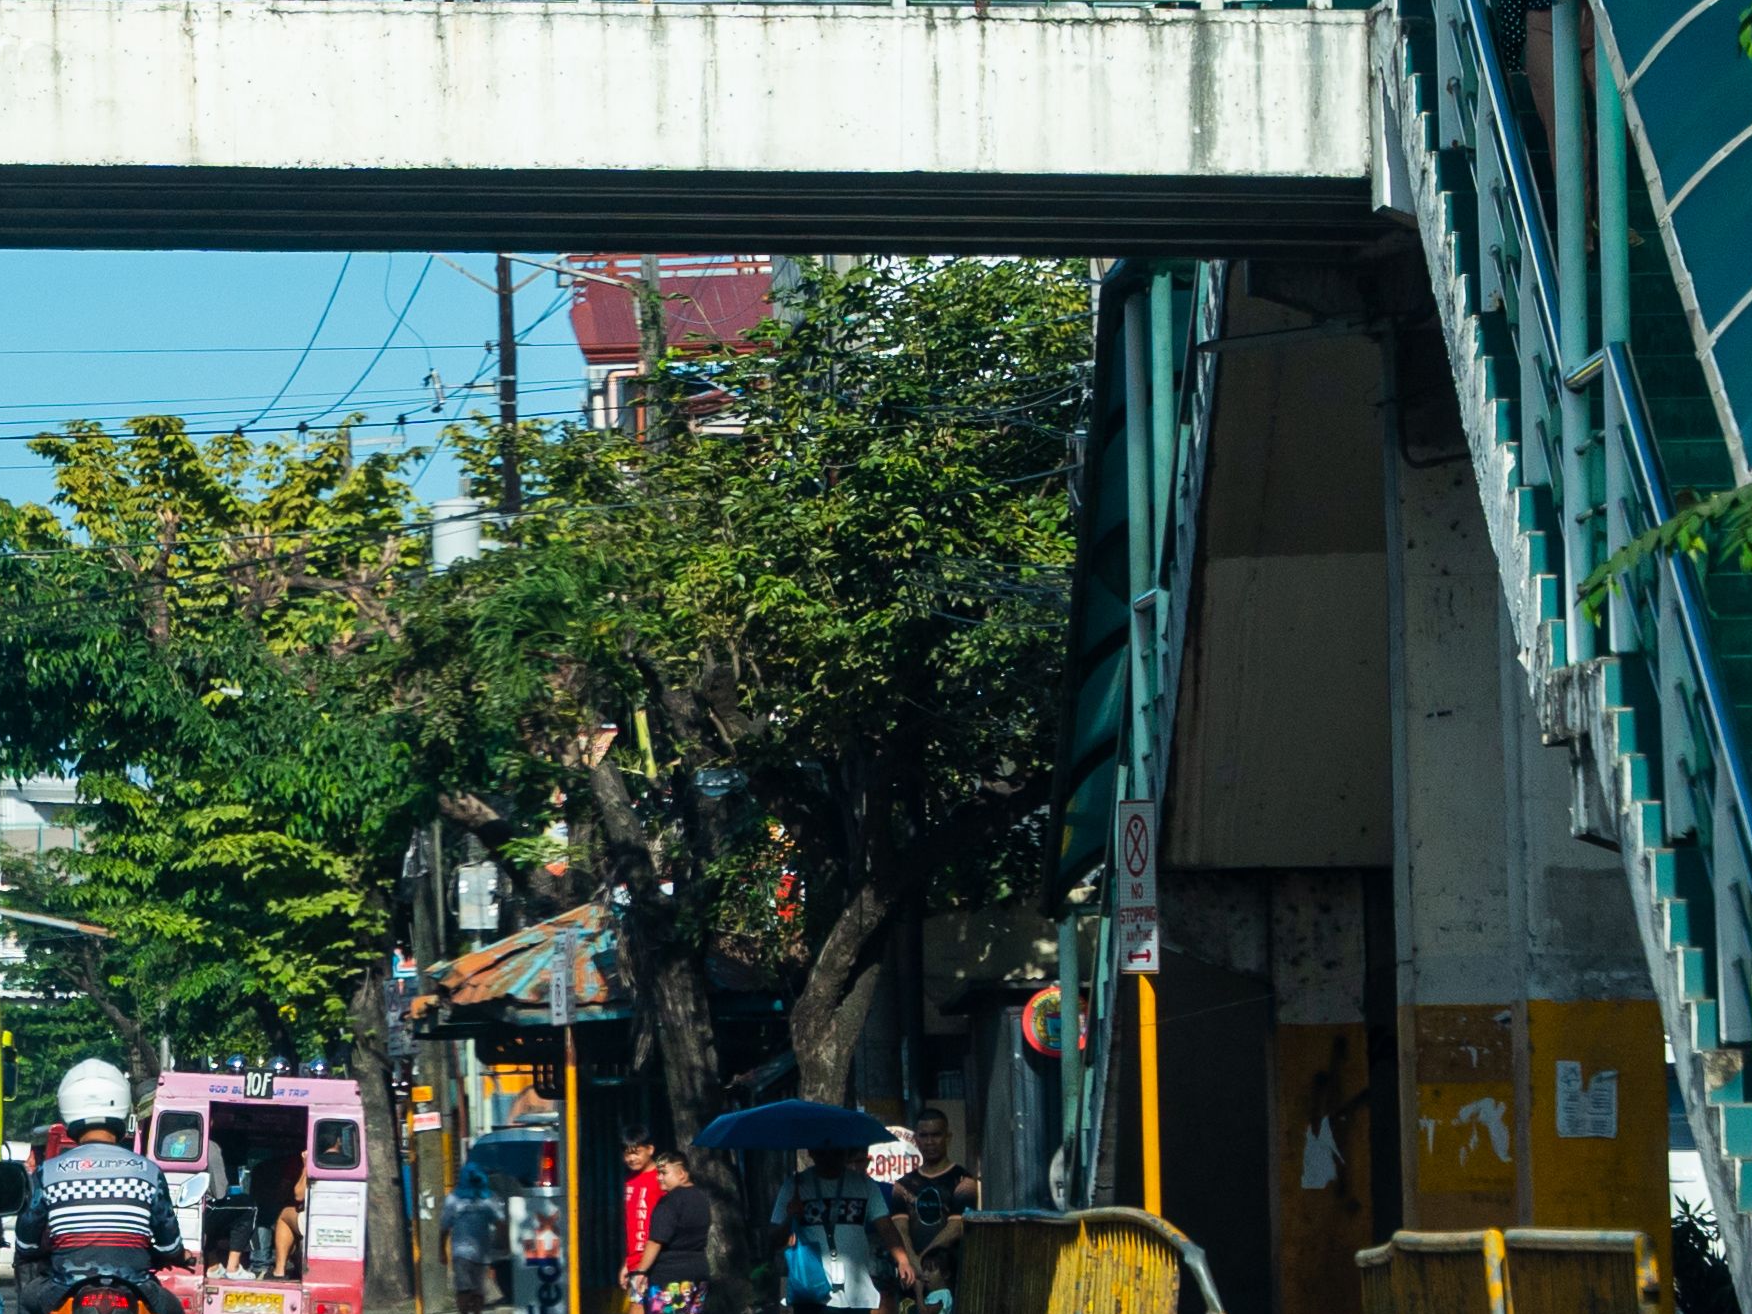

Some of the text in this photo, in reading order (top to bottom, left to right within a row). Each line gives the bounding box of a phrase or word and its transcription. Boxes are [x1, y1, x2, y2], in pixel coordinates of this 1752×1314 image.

[1131, 883, 1144, 899] NO
[1120, 906, 1157, 924] STOPPING
[209, 1085, 228, 1094] GOD
[288, 1089, 310, 1097] TRIP
[247, 1072, 273, 1097] 10F
[635, 1187, 647, 1252] JANICE
